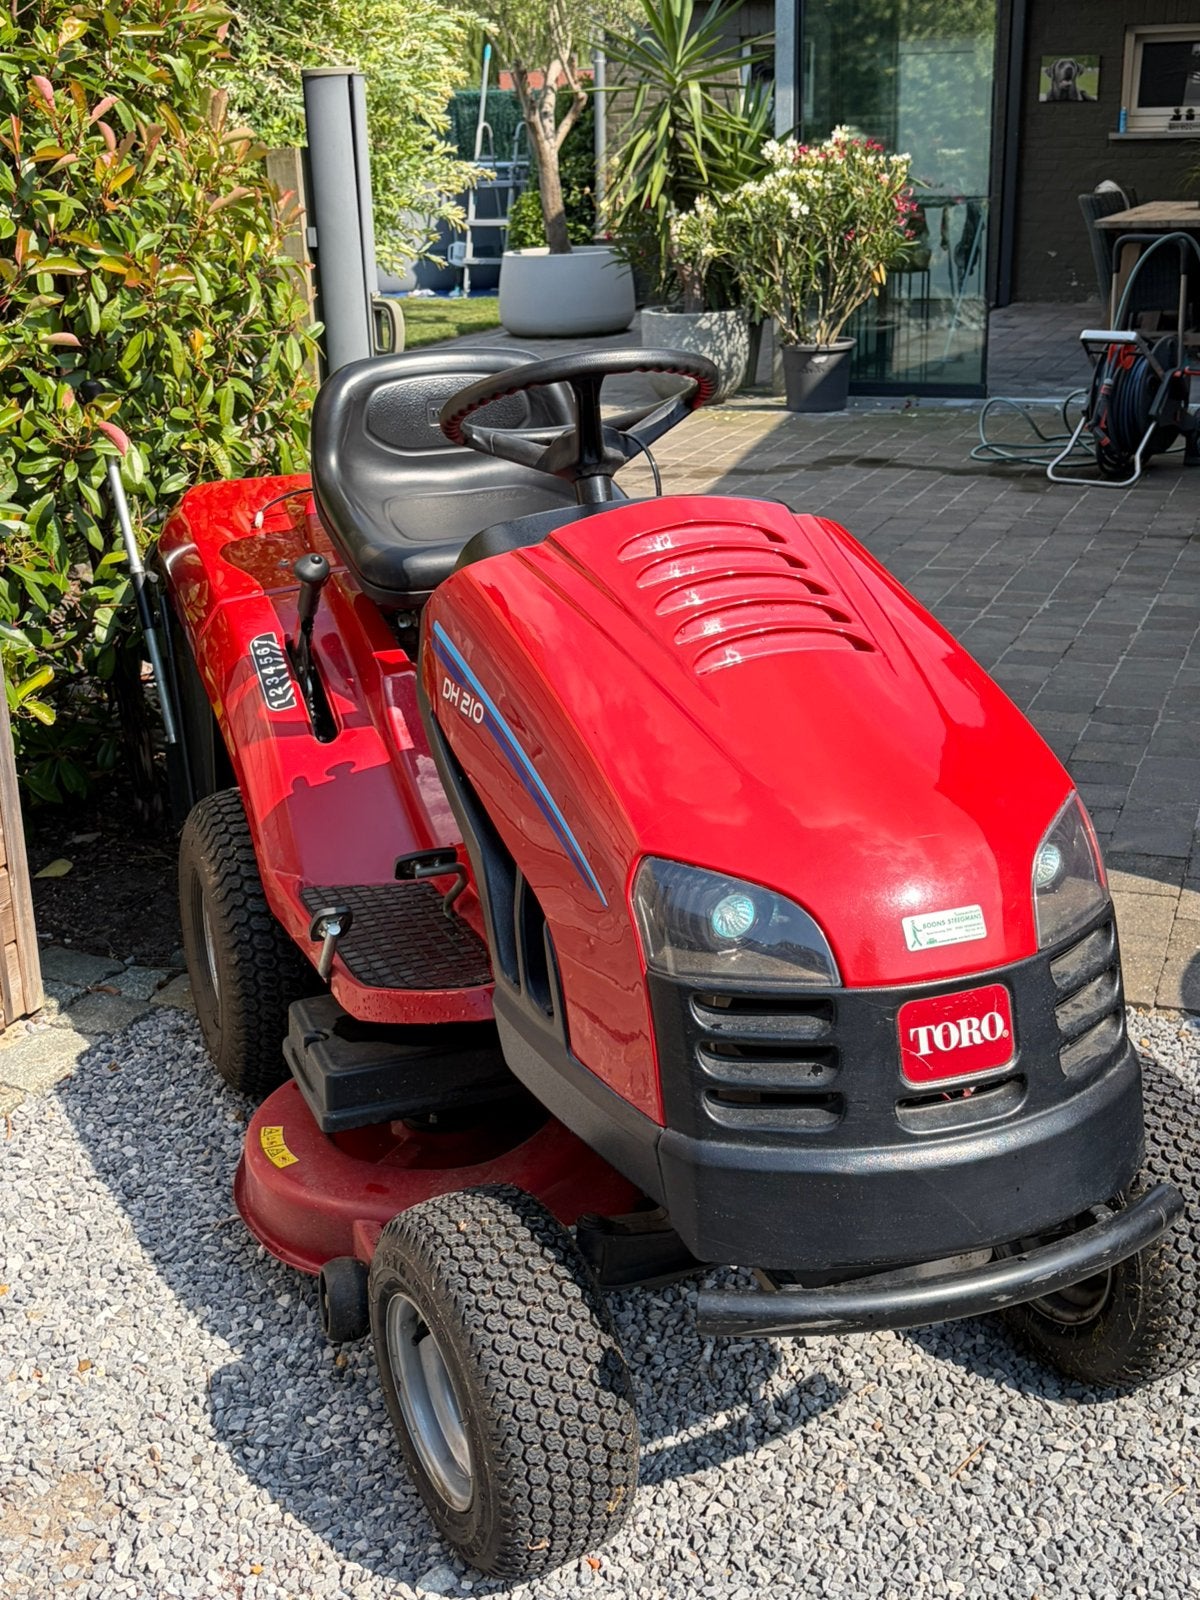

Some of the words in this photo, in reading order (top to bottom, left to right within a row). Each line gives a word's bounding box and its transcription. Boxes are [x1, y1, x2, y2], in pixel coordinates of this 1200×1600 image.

[442, 676, 461, 707] DH
[460, 691, 485, 724] 210
[922, 919, 946, 930] BOONS
[909, 1011, 1005, 1056] TORO
